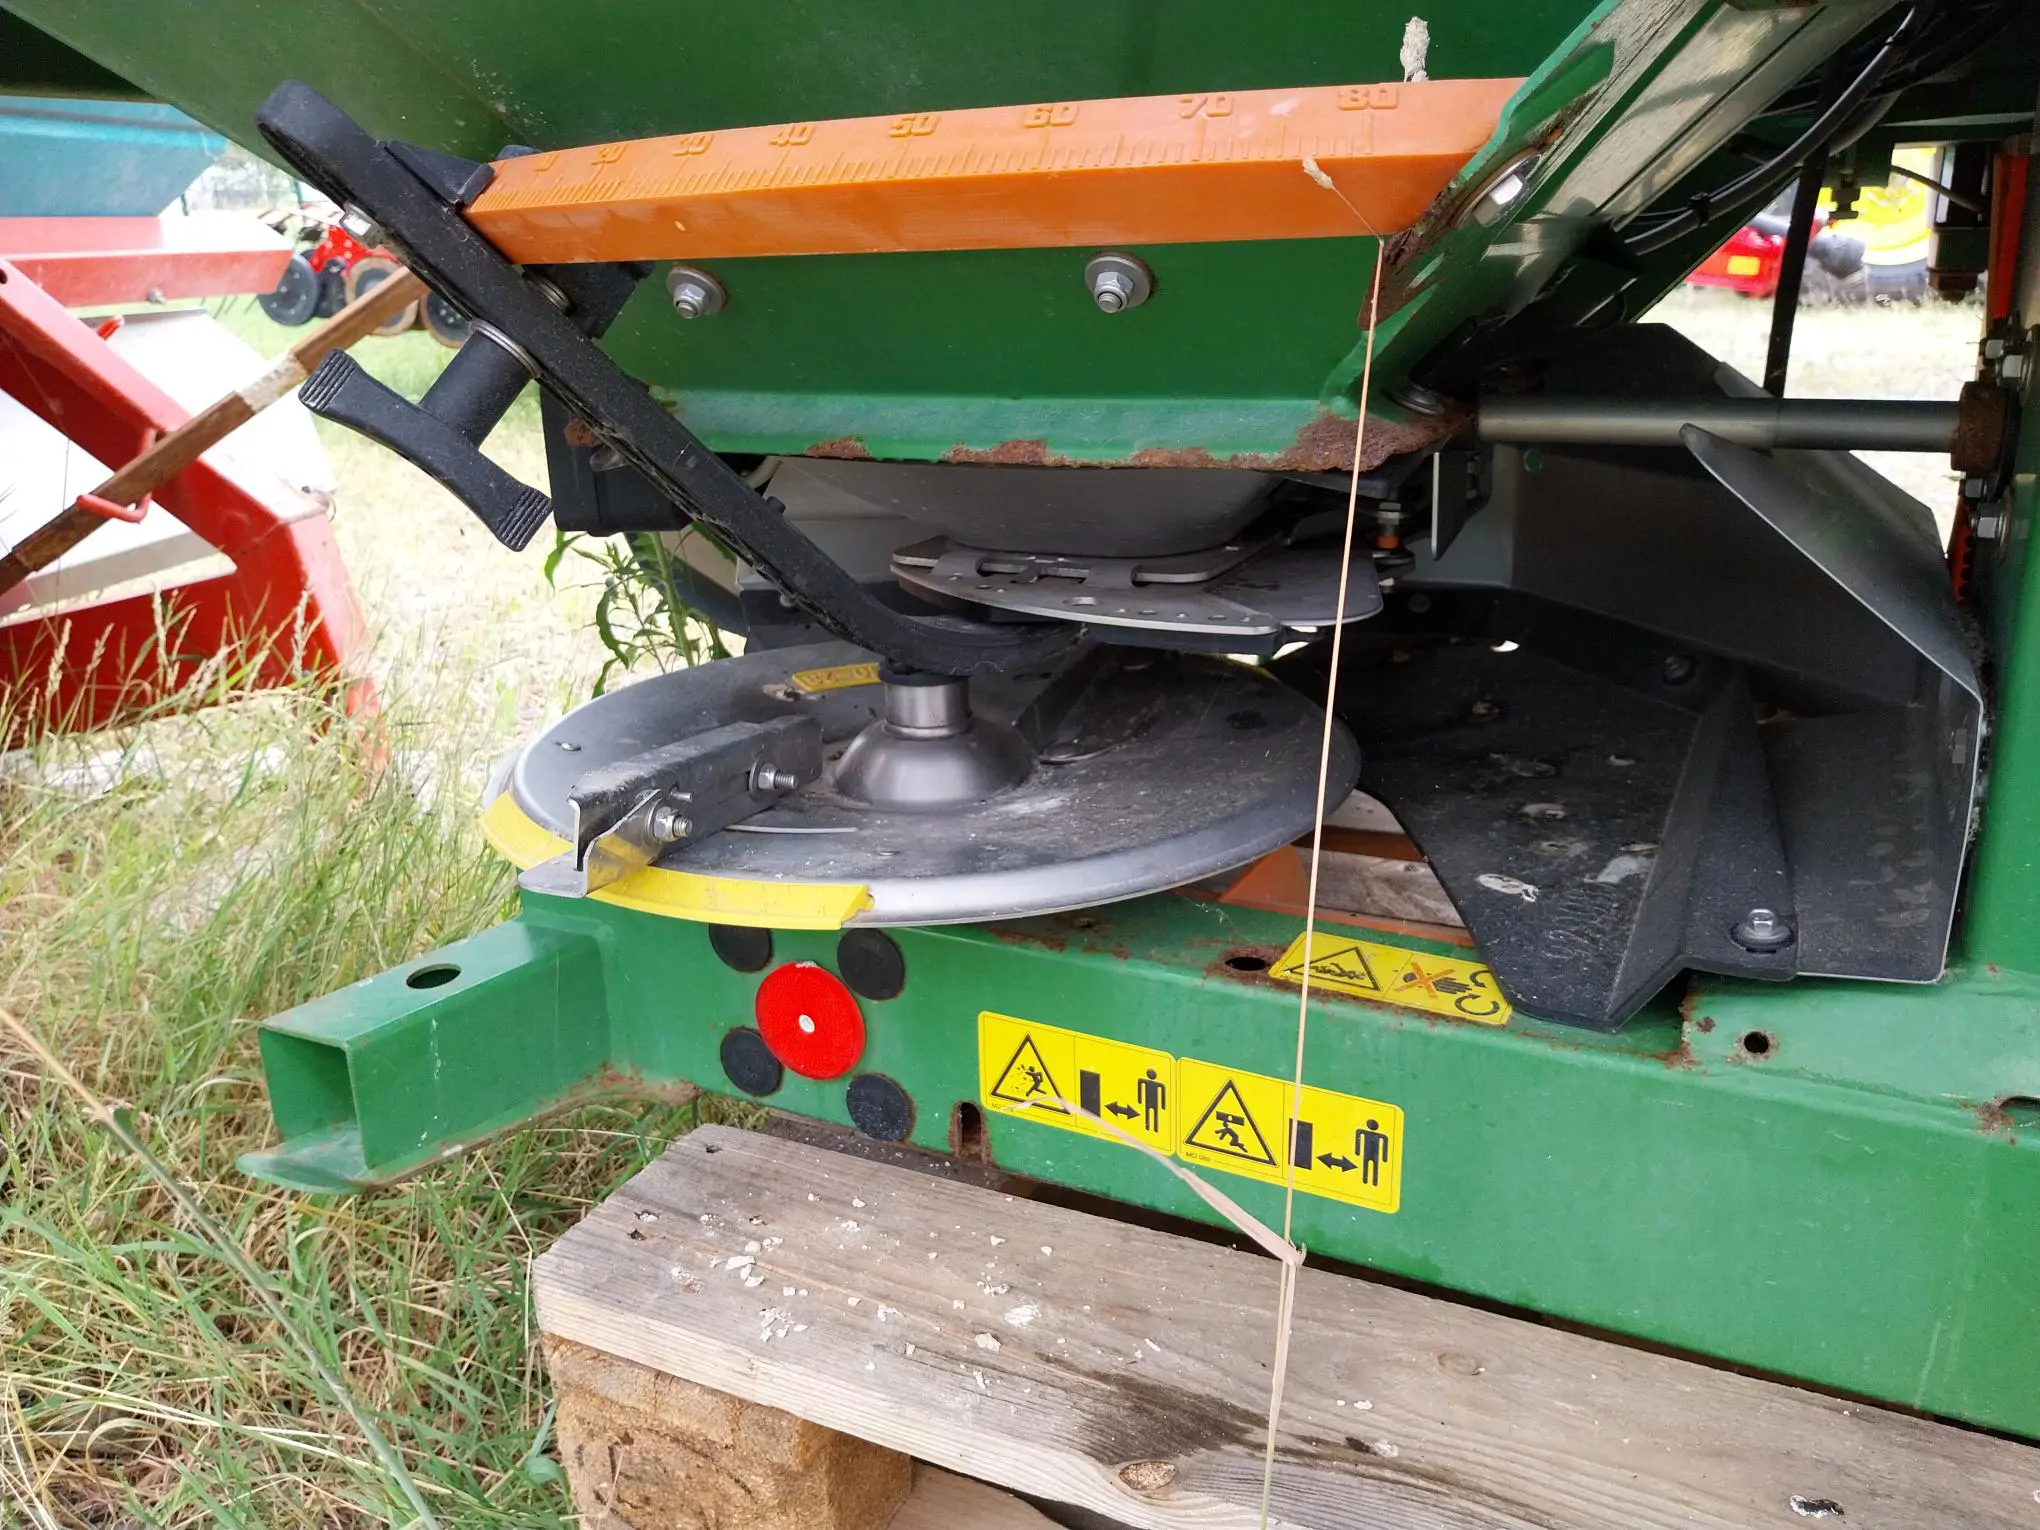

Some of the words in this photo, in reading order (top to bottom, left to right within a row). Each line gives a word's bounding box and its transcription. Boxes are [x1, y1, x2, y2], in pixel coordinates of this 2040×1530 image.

[769, 124, 817, 147] 40
[887, 114, 939, 138] 50
[1023, 104, 1080, 128] 60
[1178, 96, 1235, 119] 70
[1337, 87, 1399, 110] 80
